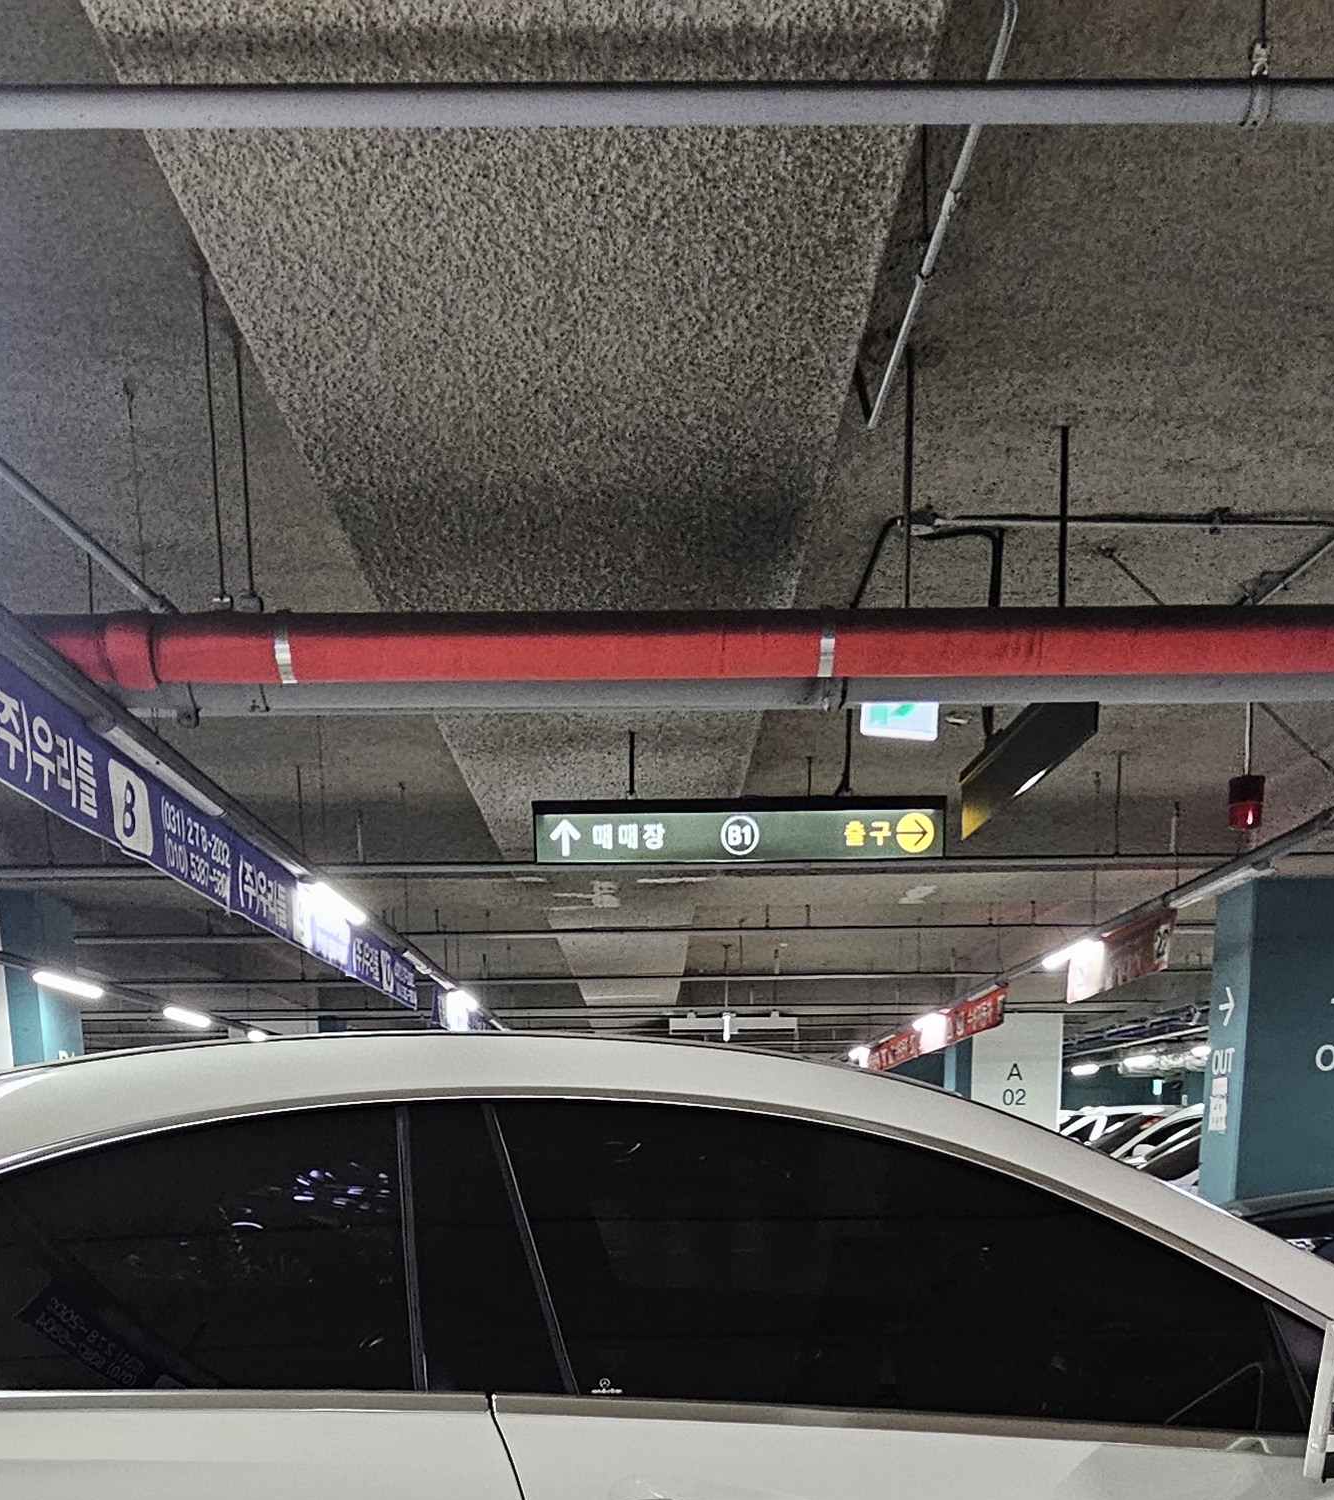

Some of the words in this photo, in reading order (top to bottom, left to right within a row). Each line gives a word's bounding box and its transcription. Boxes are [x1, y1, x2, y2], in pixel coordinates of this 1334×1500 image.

[727, 824, 753, 847] B1
[843, 820, 892, 848] 출구
[1006, 1062, 1023, 1081] A
[1211, 1047, 1236, 1075] OUT
[1002, 1088, 1026, 1106] 02
